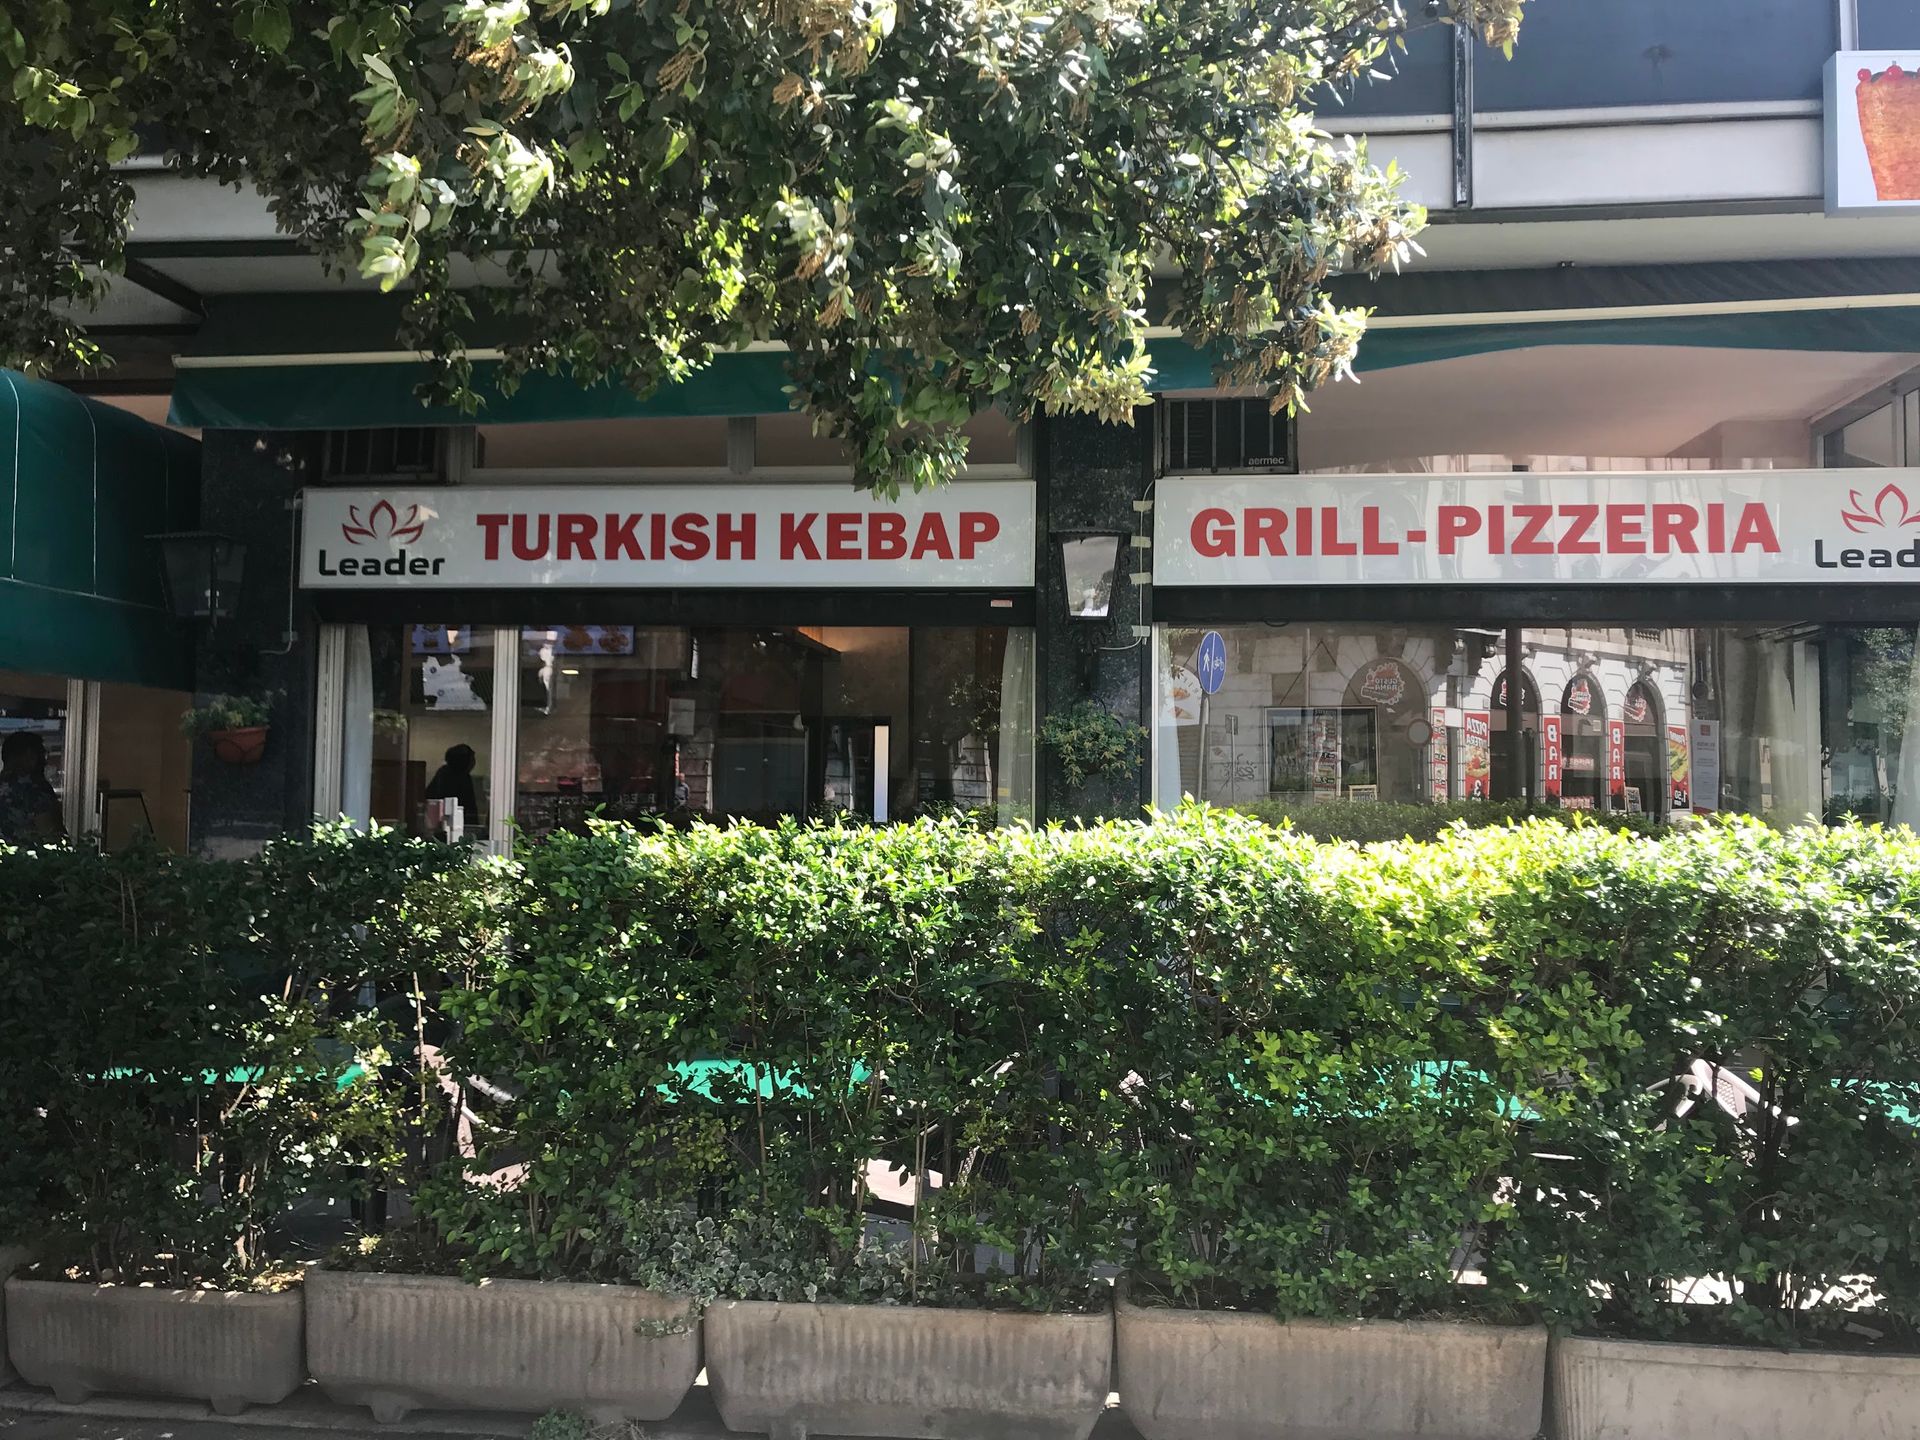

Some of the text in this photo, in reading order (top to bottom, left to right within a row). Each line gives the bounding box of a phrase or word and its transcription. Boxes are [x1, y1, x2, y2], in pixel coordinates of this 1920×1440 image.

[1248, 457, 1285, 465] aermec
[476, 512, 1000, 561] TURKISH KEBAP
[1190, 503, 1780, 558] GRILL-PIZZERIA
[318, 549, 446, 577] Leader
